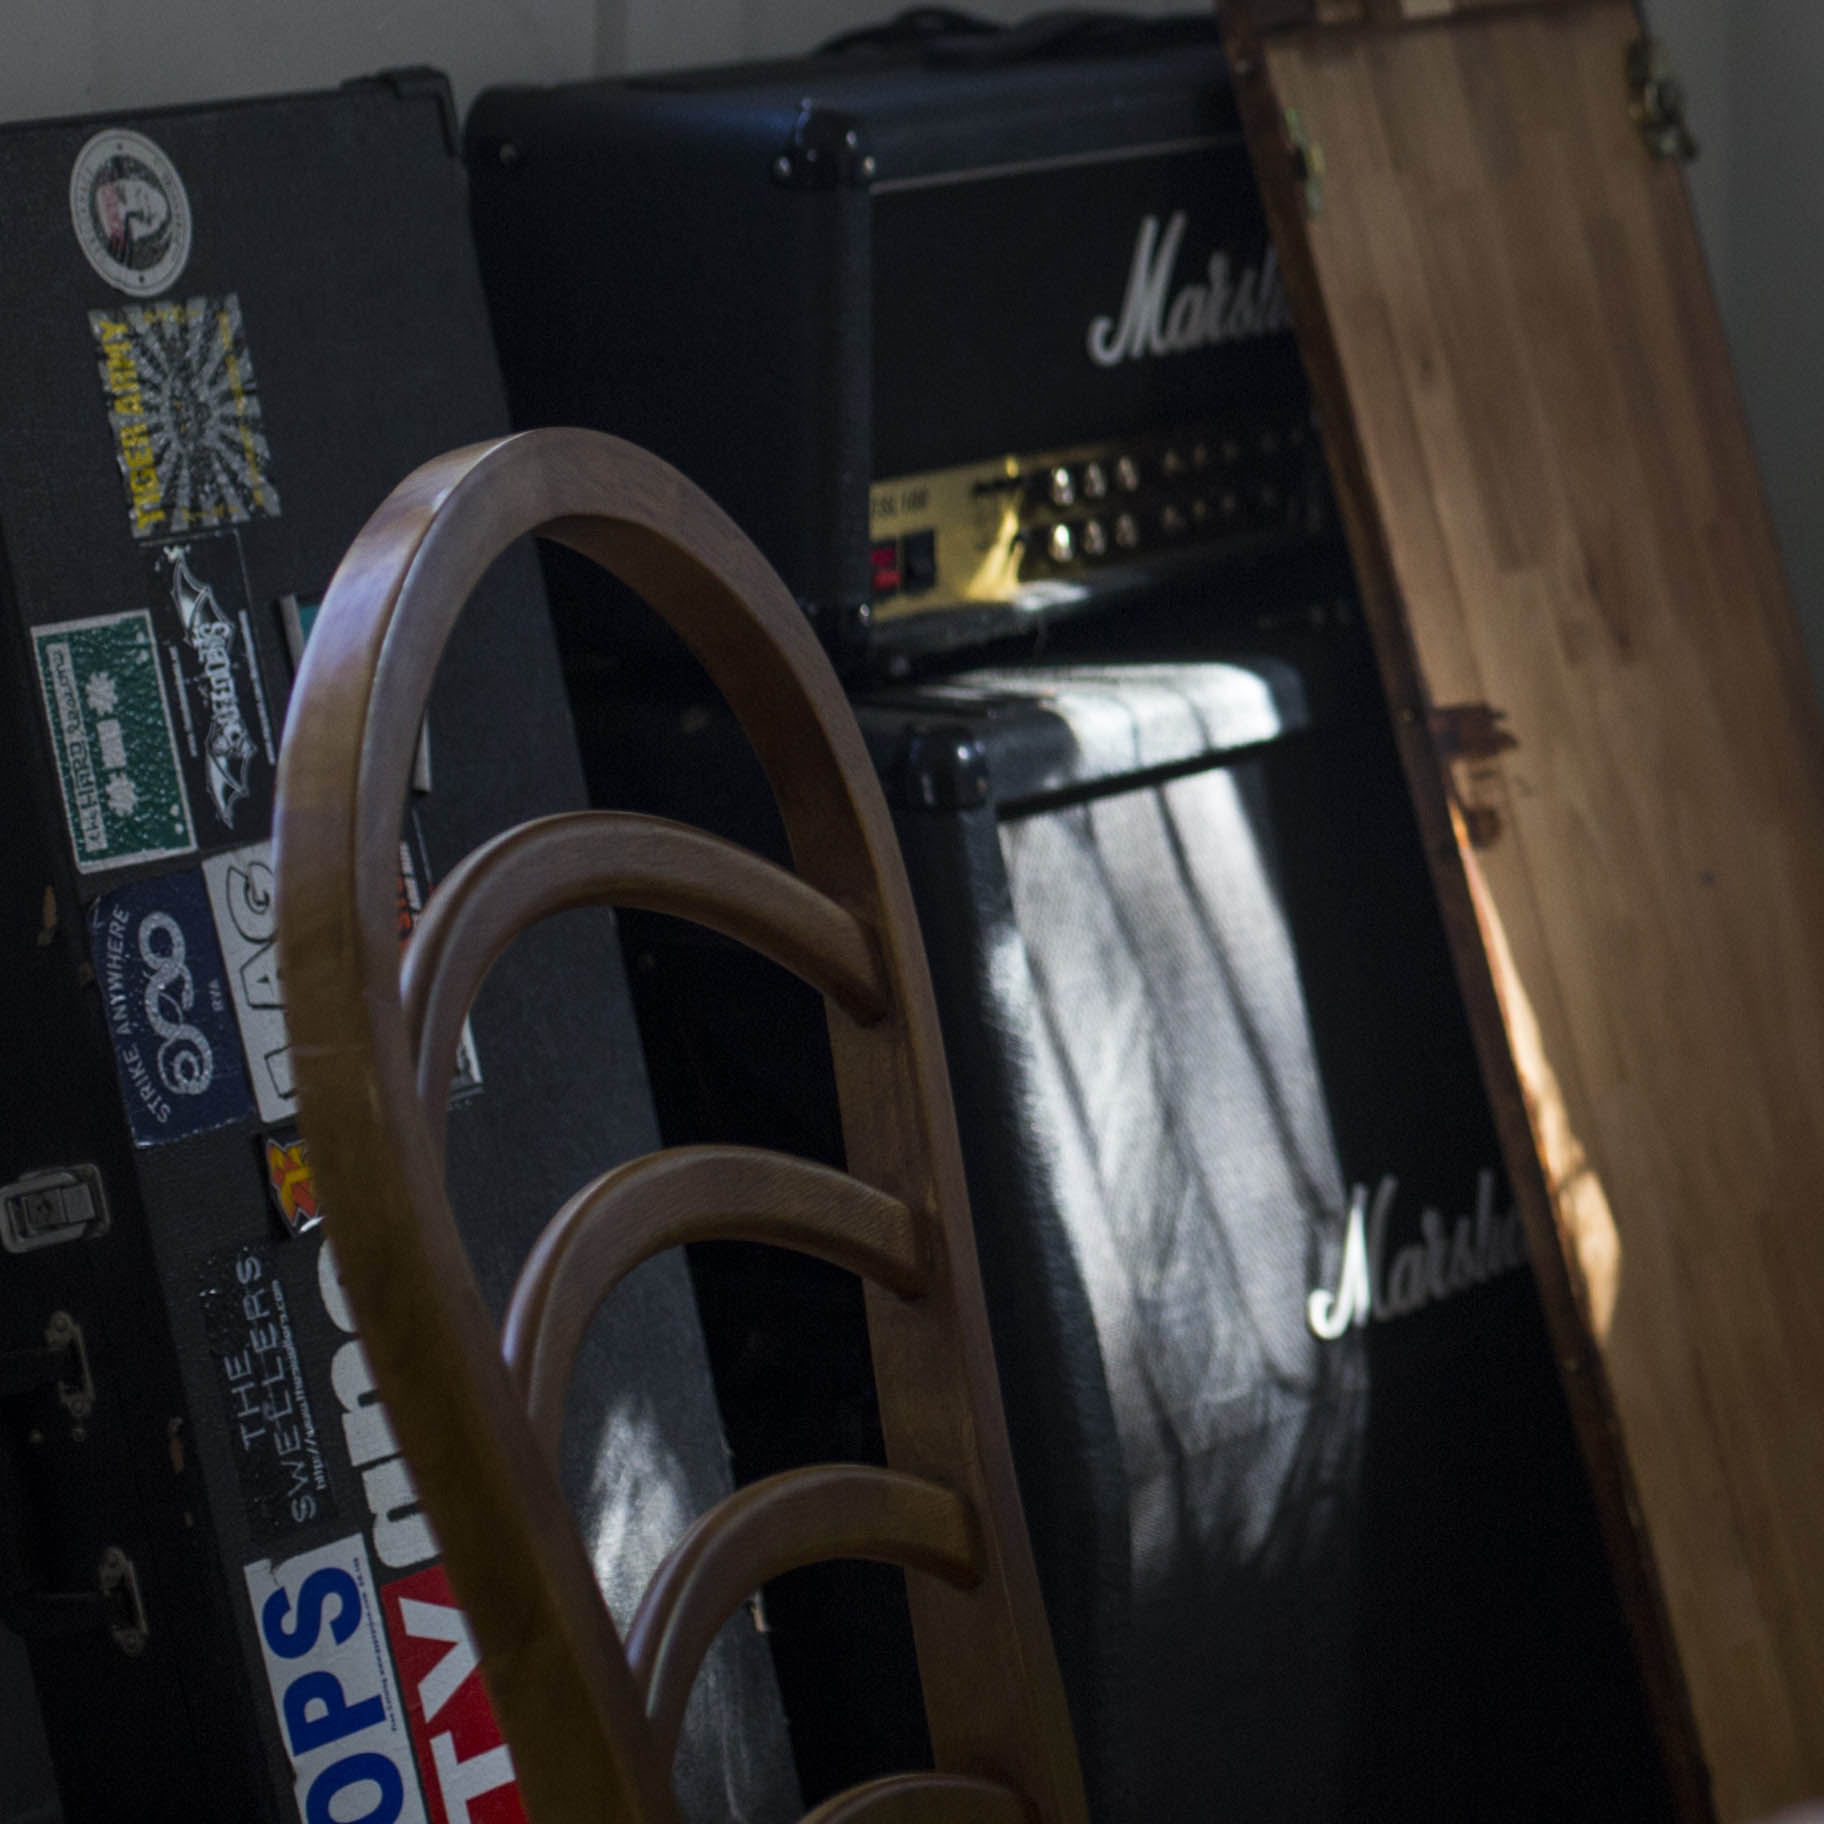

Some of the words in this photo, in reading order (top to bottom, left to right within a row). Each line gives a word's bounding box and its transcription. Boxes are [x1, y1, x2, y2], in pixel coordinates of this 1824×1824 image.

[98, 316, 145, 418] ARMY
[119, 423, 167, 529] TIGER
[104, 903, 133, 1036] ANYWHERE
[209, 978, 223, 1013] RVA
[122, 1041, 174, 1126] STRIKE
[224, 1351, 267, 1451] THE
[236, 1255, 319, 1524] SWELLERS
